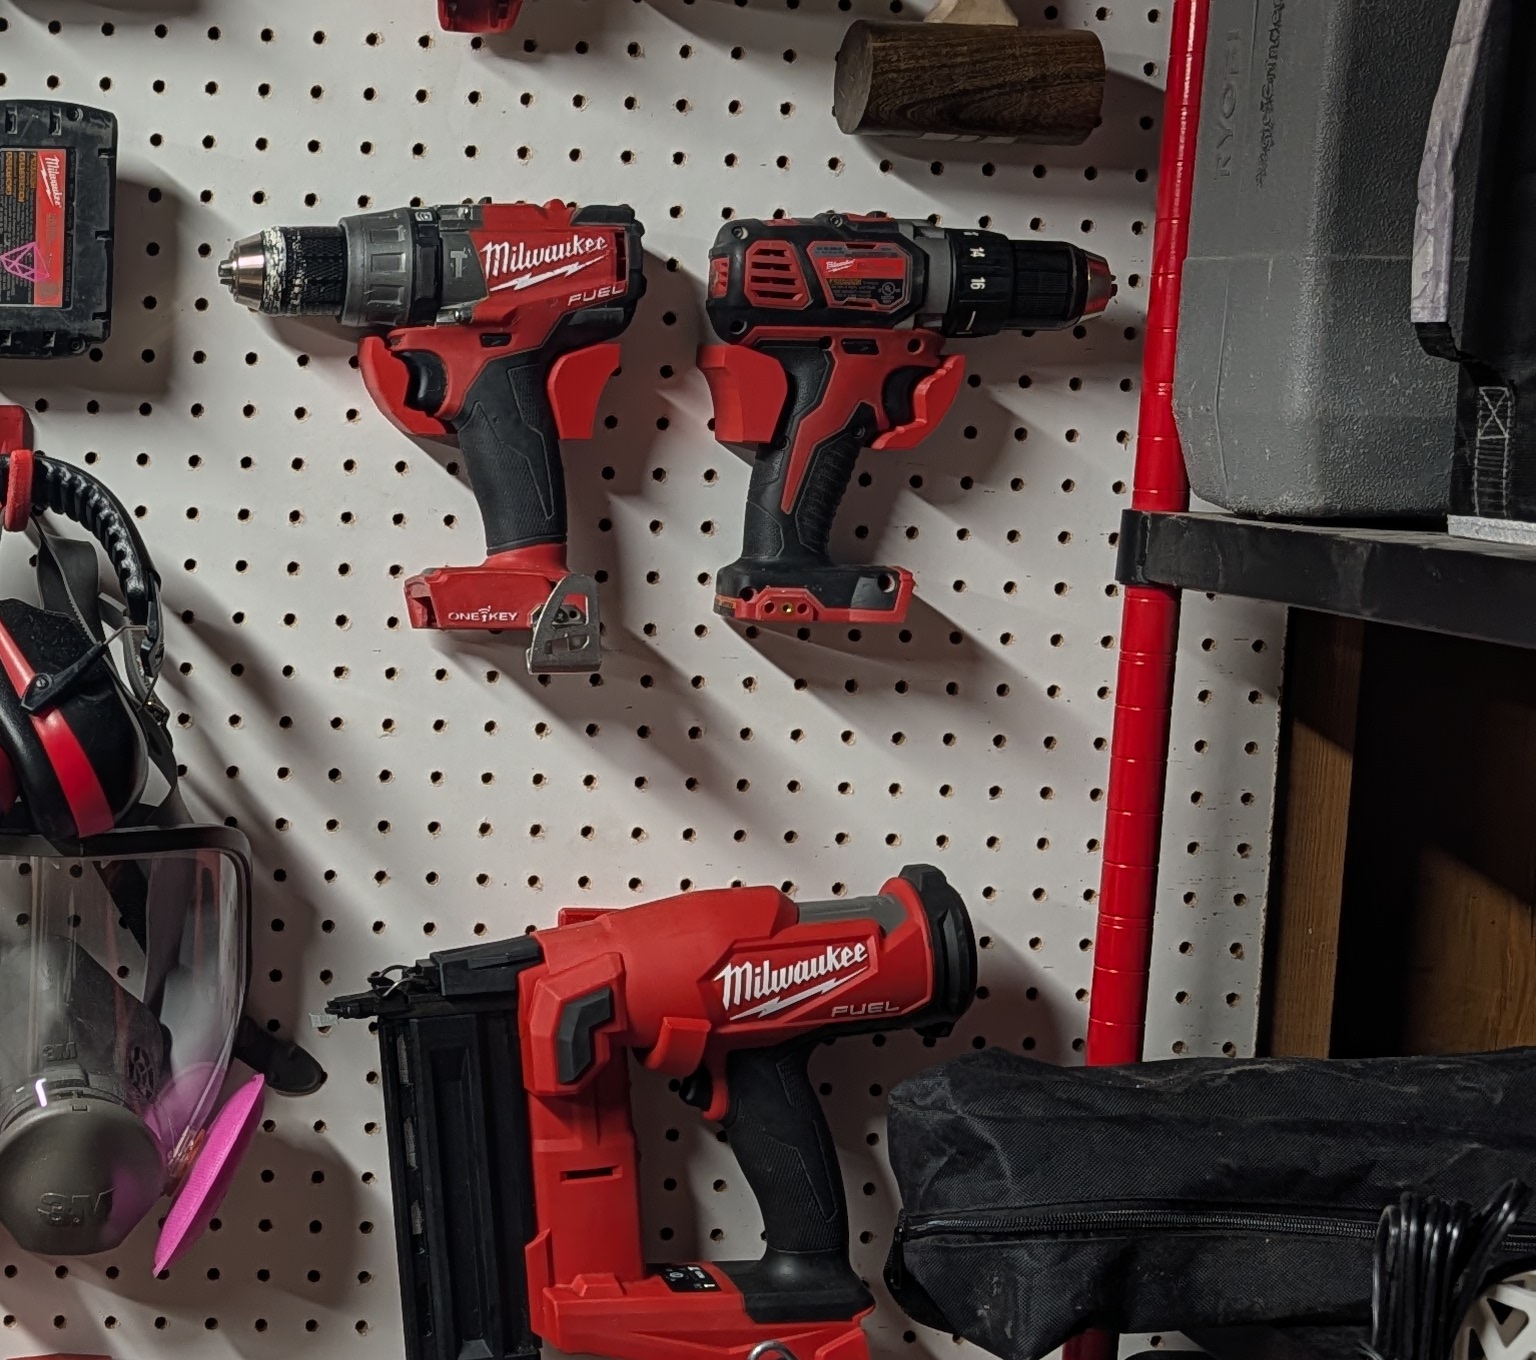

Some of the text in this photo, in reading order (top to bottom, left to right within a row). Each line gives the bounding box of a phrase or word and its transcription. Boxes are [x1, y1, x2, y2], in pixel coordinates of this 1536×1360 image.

[45, 155, 63, 207] Milwaukee
[481, 235, 607, 279] Milwaukee
[970, 246, 985, 258] 14
[568, 285, 623, 307] FUEL
[970, 276, 985, 290] 16
[714, 941, 869, 1010] Milwaukee
[831, 998, 901, 1019] FUEL
[37, 1187, 117, 1226] 3M
